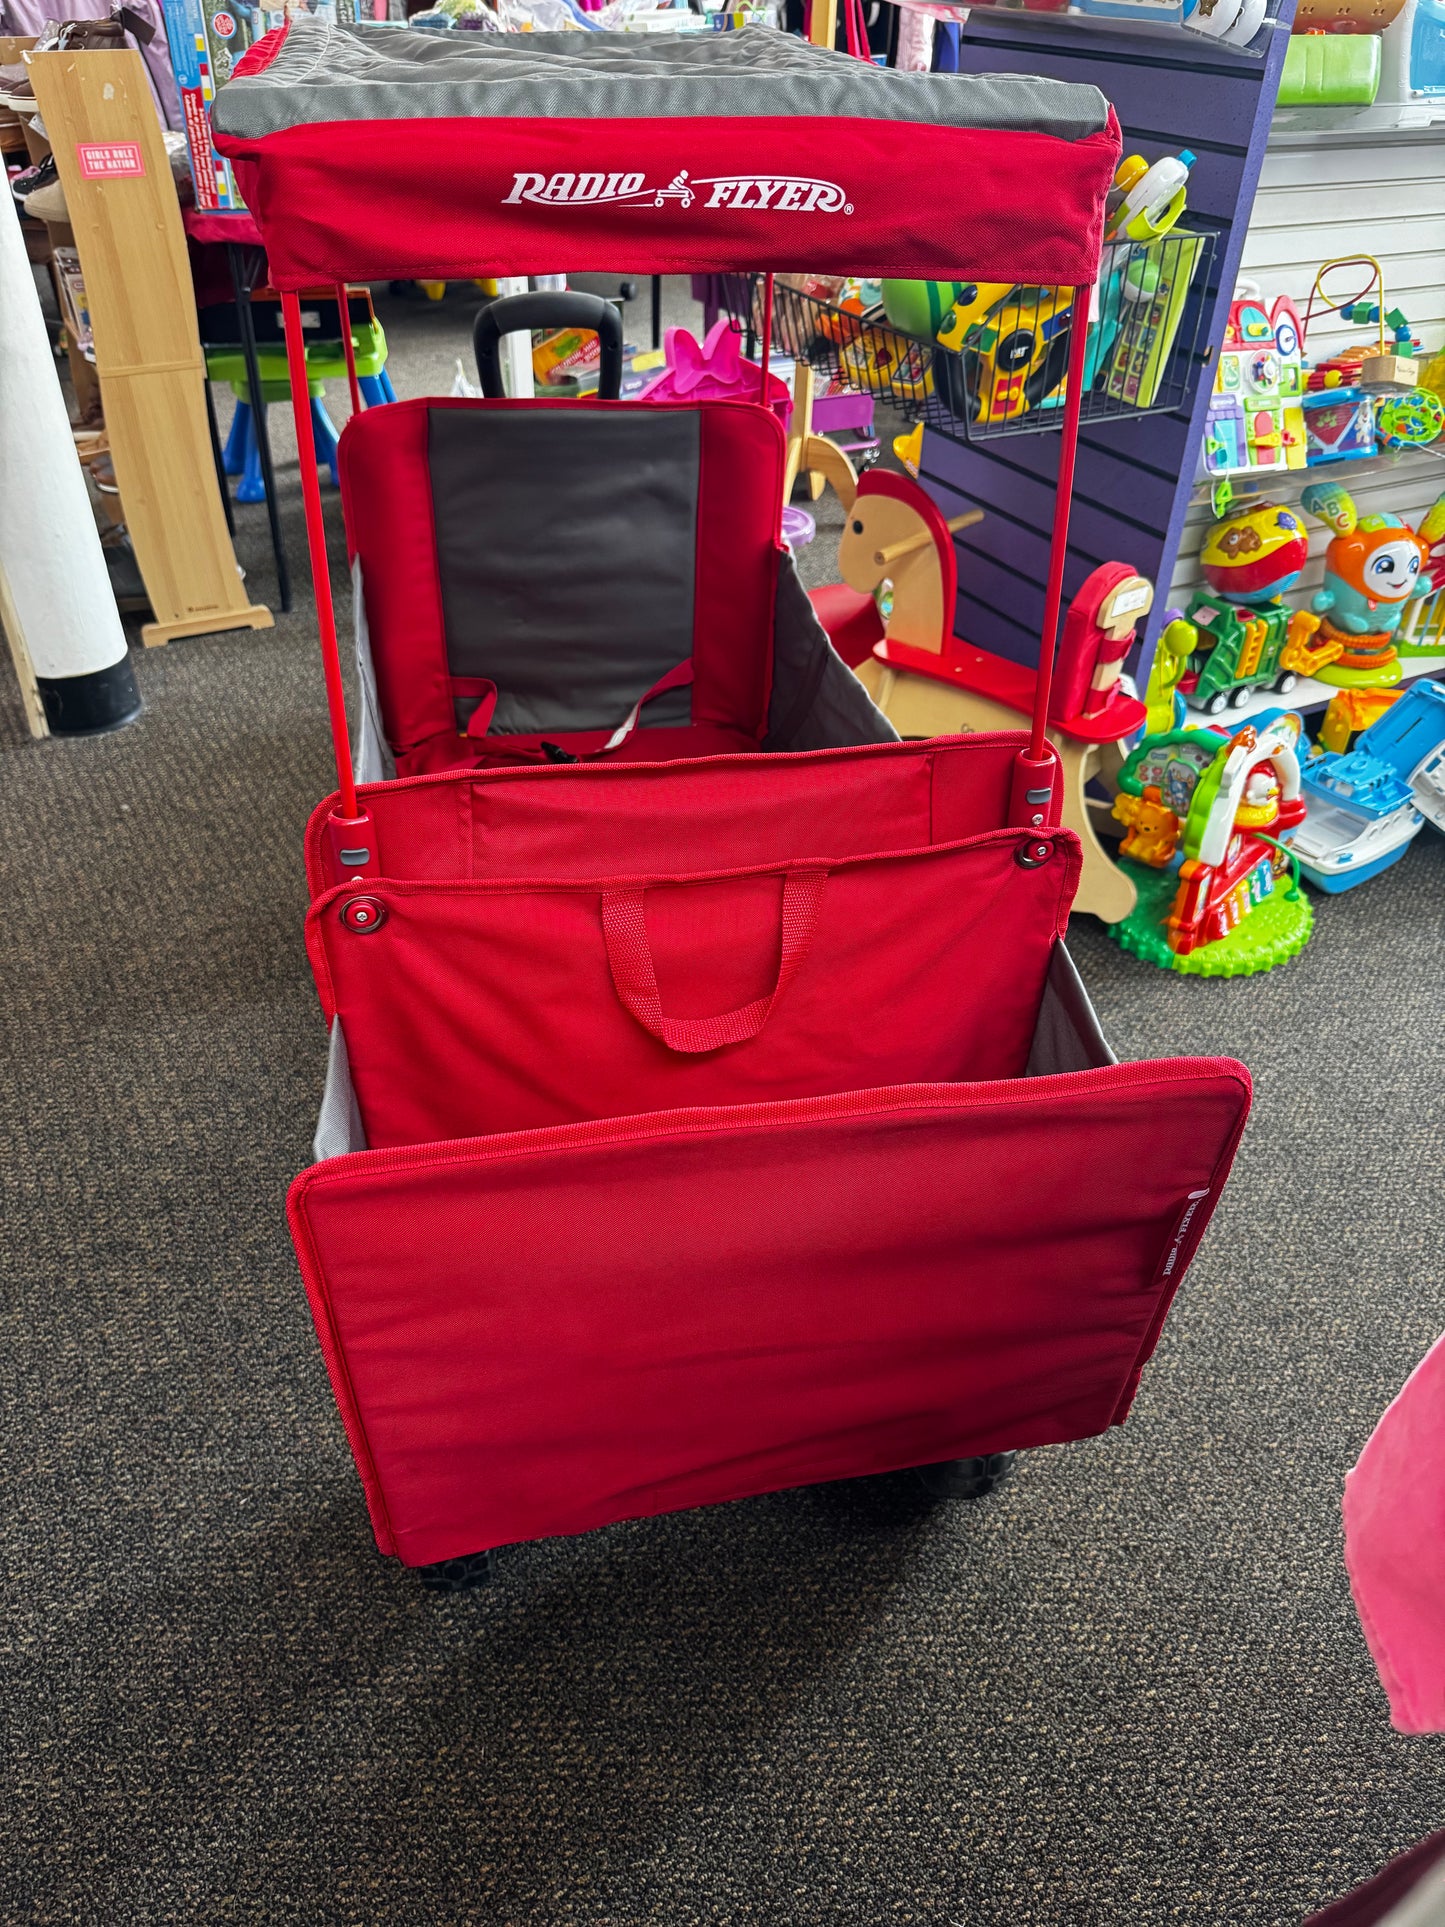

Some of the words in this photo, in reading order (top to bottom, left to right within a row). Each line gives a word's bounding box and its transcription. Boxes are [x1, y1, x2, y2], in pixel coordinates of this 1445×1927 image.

[86, 149, 110, 160] GIRLS
[112, 149, 134, 159] RULE
[88, 160, 105, 170] THE
[106, 159, 136, 169] NATION
[501, 172, 650, 206] RADIO
[702, 175, 846, 213] FLYER
